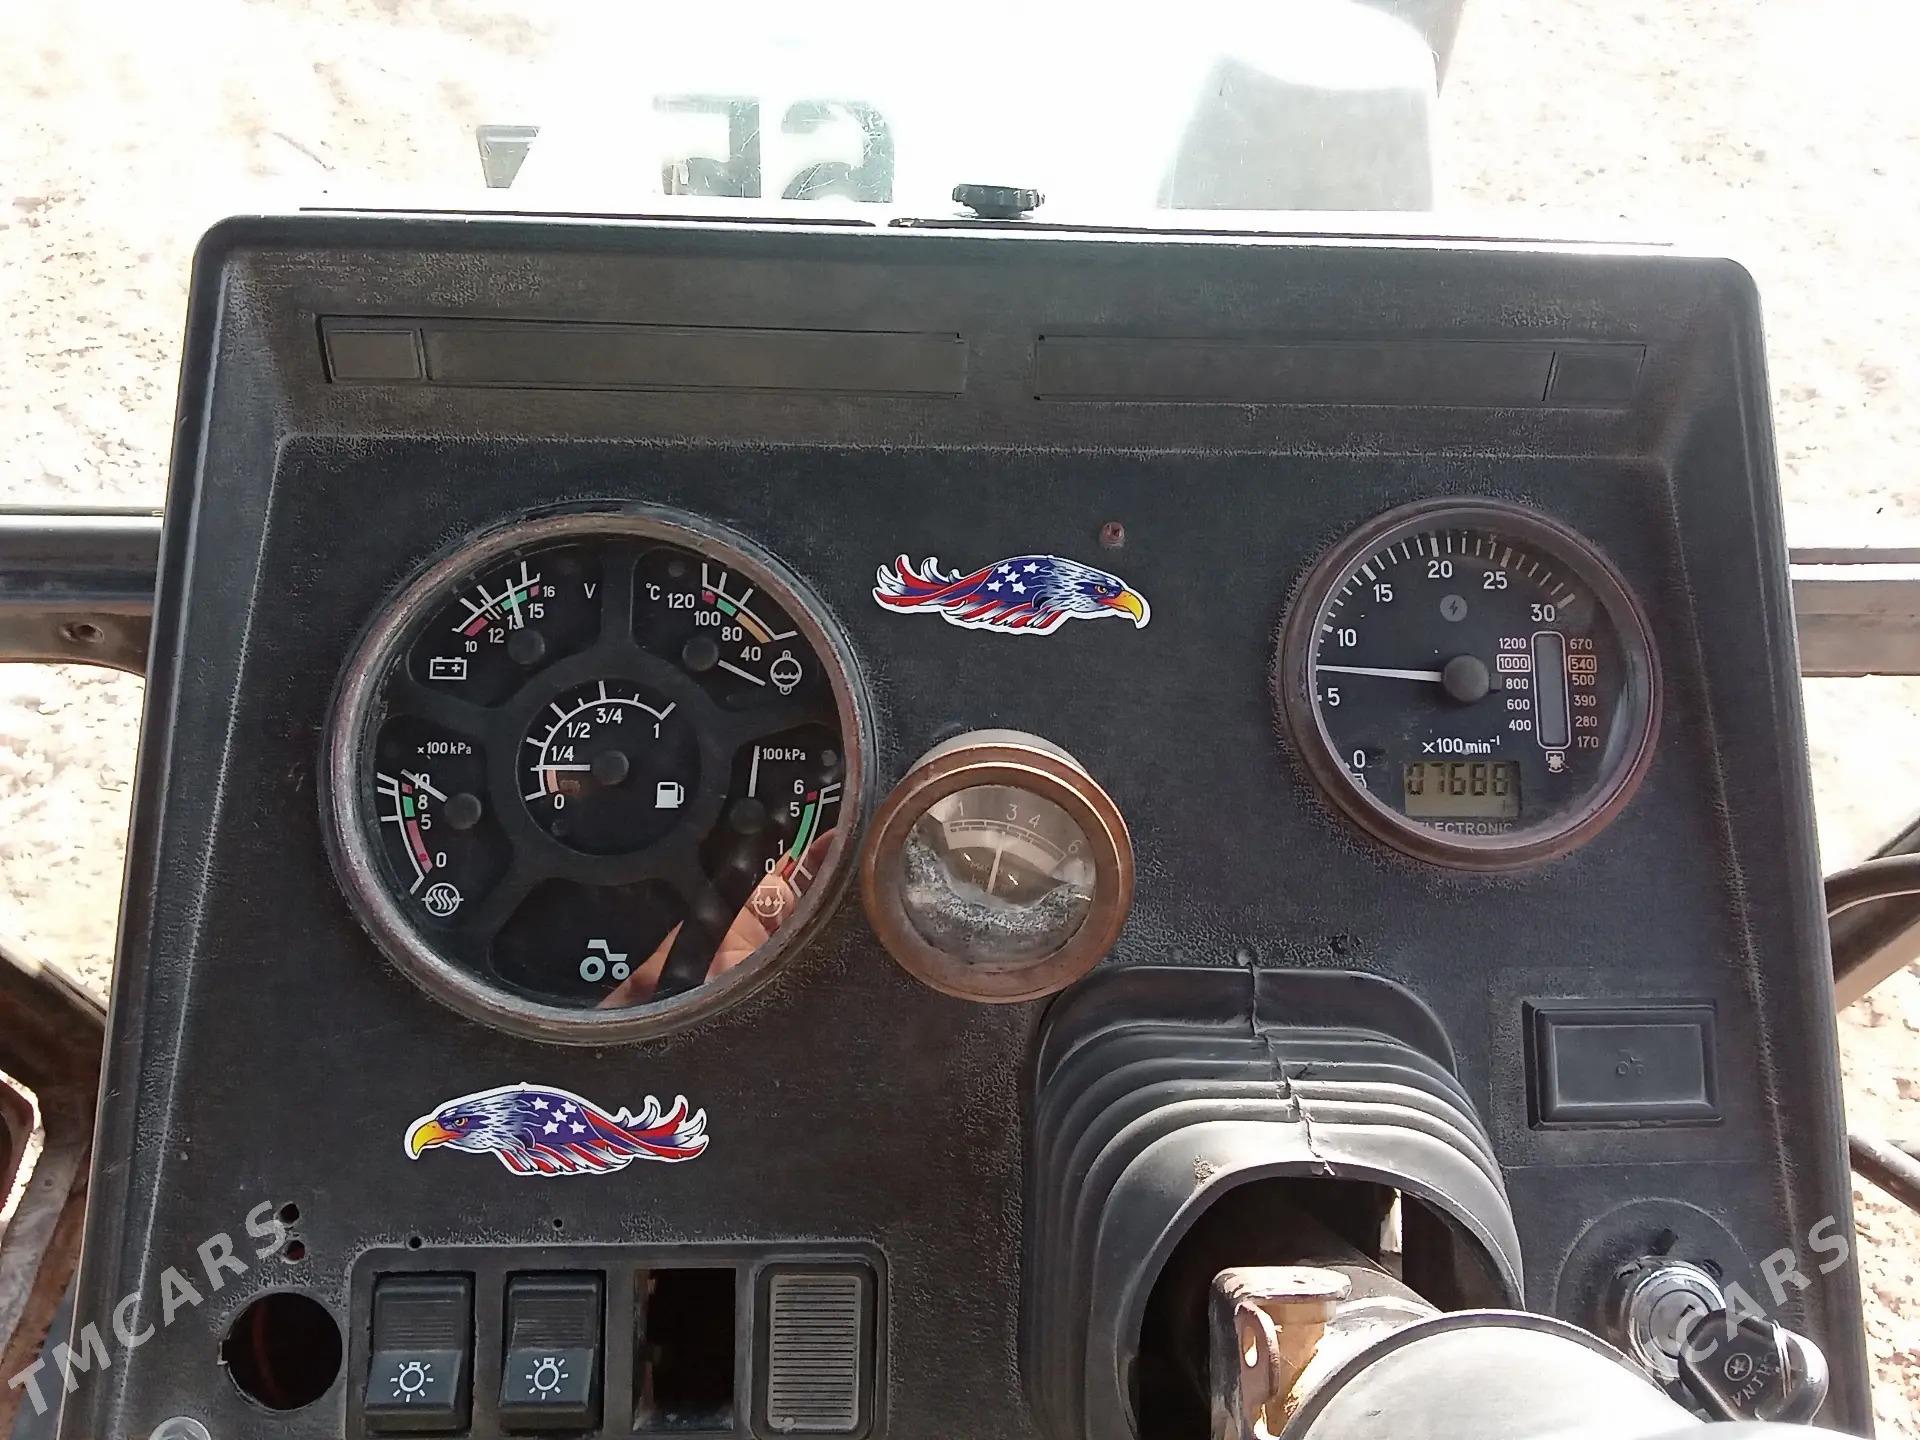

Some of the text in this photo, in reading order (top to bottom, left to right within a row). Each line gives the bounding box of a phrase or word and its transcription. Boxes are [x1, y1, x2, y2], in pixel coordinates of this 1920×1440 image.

[1427, 560, 1453, 579] 20
[1483, 572, 1508, 590] 25
[543, 586, 555, 597] 16
[584, 583, 596, 598] V
[1374, 584, 1393, 602] 15
[667, 593, 694, 609] 120
[528, 603, 544, 618] 15
[1530, 604, 1556, 622] 30
[694, 611, 720, 626] 100
[488, 628, 504, 643] 12
[722, 626, 742, 641] 80
[1337, 629, 1357, 647] 10
[465, 641, 477, 652] 10
[1499, 638, 1527, 650] 1200
[1570, 638, 1592, 650] 670
[740, 646, 761, 661] 40
[1500, 658, 1528, 669] 1000
[1571, 659, 1594, 670] 540
[1506, 678, 1529, 690] 800
[1572, 675, 1595, 686] 500
[1327, 688, 1341, 706] 5
[1573, 695, 1596, 707] 390
[1507, 699, 1530, 711] 600
[596, 708, 623, 724] 3/4
[1575, 716, 1598, 728] 280
[566, 722, 591, 738] 1/2
[653, 723, 660, 739] 1
[1509, 720, 1531, 732] 400
[450, 742, 472, 754] kPa
[1577, 736, 1599, 748] 170
[551, 745, 574, 761] 1/4
[785, 749, 806, 761] kPa
[1353, 750, 1366, 768] 0
[793, 779, 804, 795] 6
[417, 794, 429, 810] 8
[554, 794, 565, 810] 0
[789, 801, 801, 817] 5
[1006, 803, 1018, 821] 3
[421, 814, 432, 830] 5
[1028, 814, 1041, 828] 4
[778, 839, 784, 855] 1
[1067, 839, 1082, 854] 6
[436, 852, 447, 868] 0
[765, 858, 776, 874] 0
